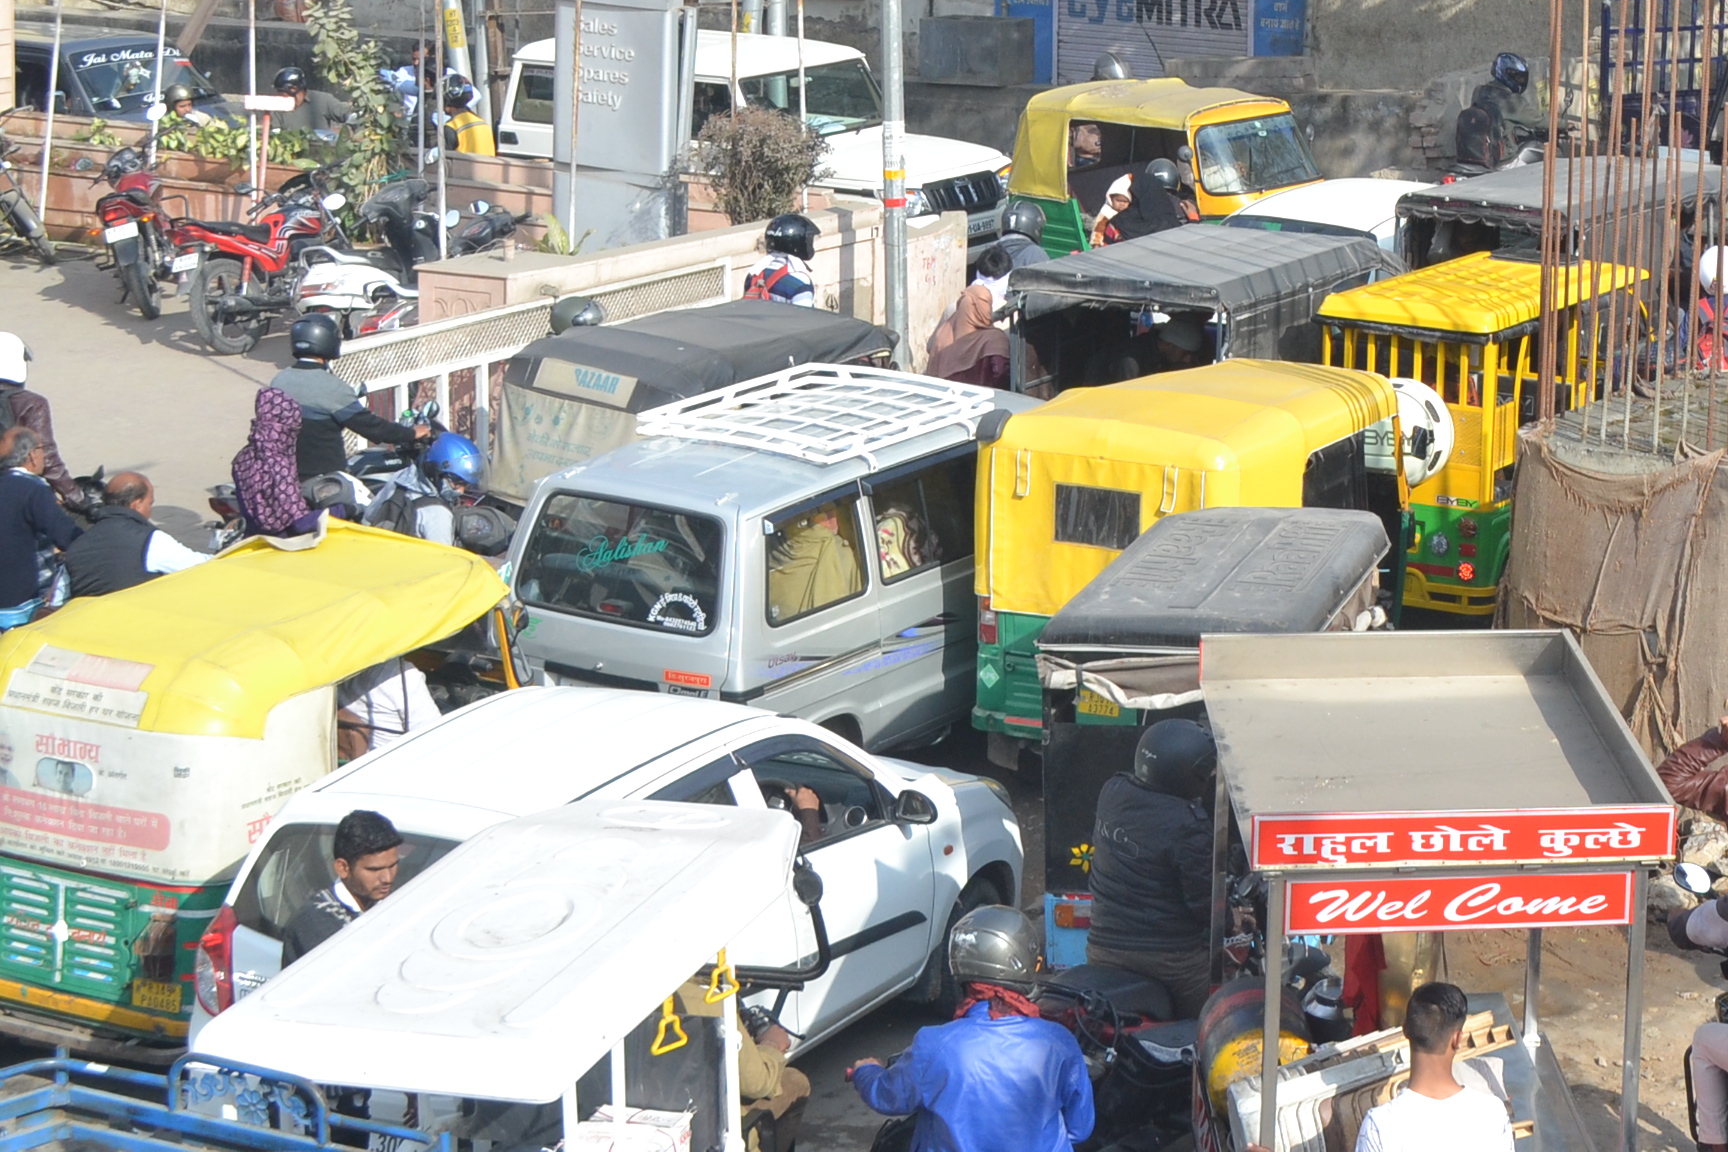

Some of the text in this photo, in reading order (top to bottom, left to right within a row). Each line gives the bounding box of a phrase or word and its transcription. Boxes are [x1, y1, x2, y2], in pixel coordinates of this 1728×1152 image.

[78, 46, 182, 68] Jai Mata Di
[42, 696, 61, 709] सहज
[62, 698, 87, 713] बिजली
[88, 704, 100, 717] हर
[102, 706, 114, 718] घर
[88, 808, 113, 822] बिजली
[1276, 822, 1647, 864] राहुल छोले कुल्छे
[1308, 882, 1609, 923] Wel Come
